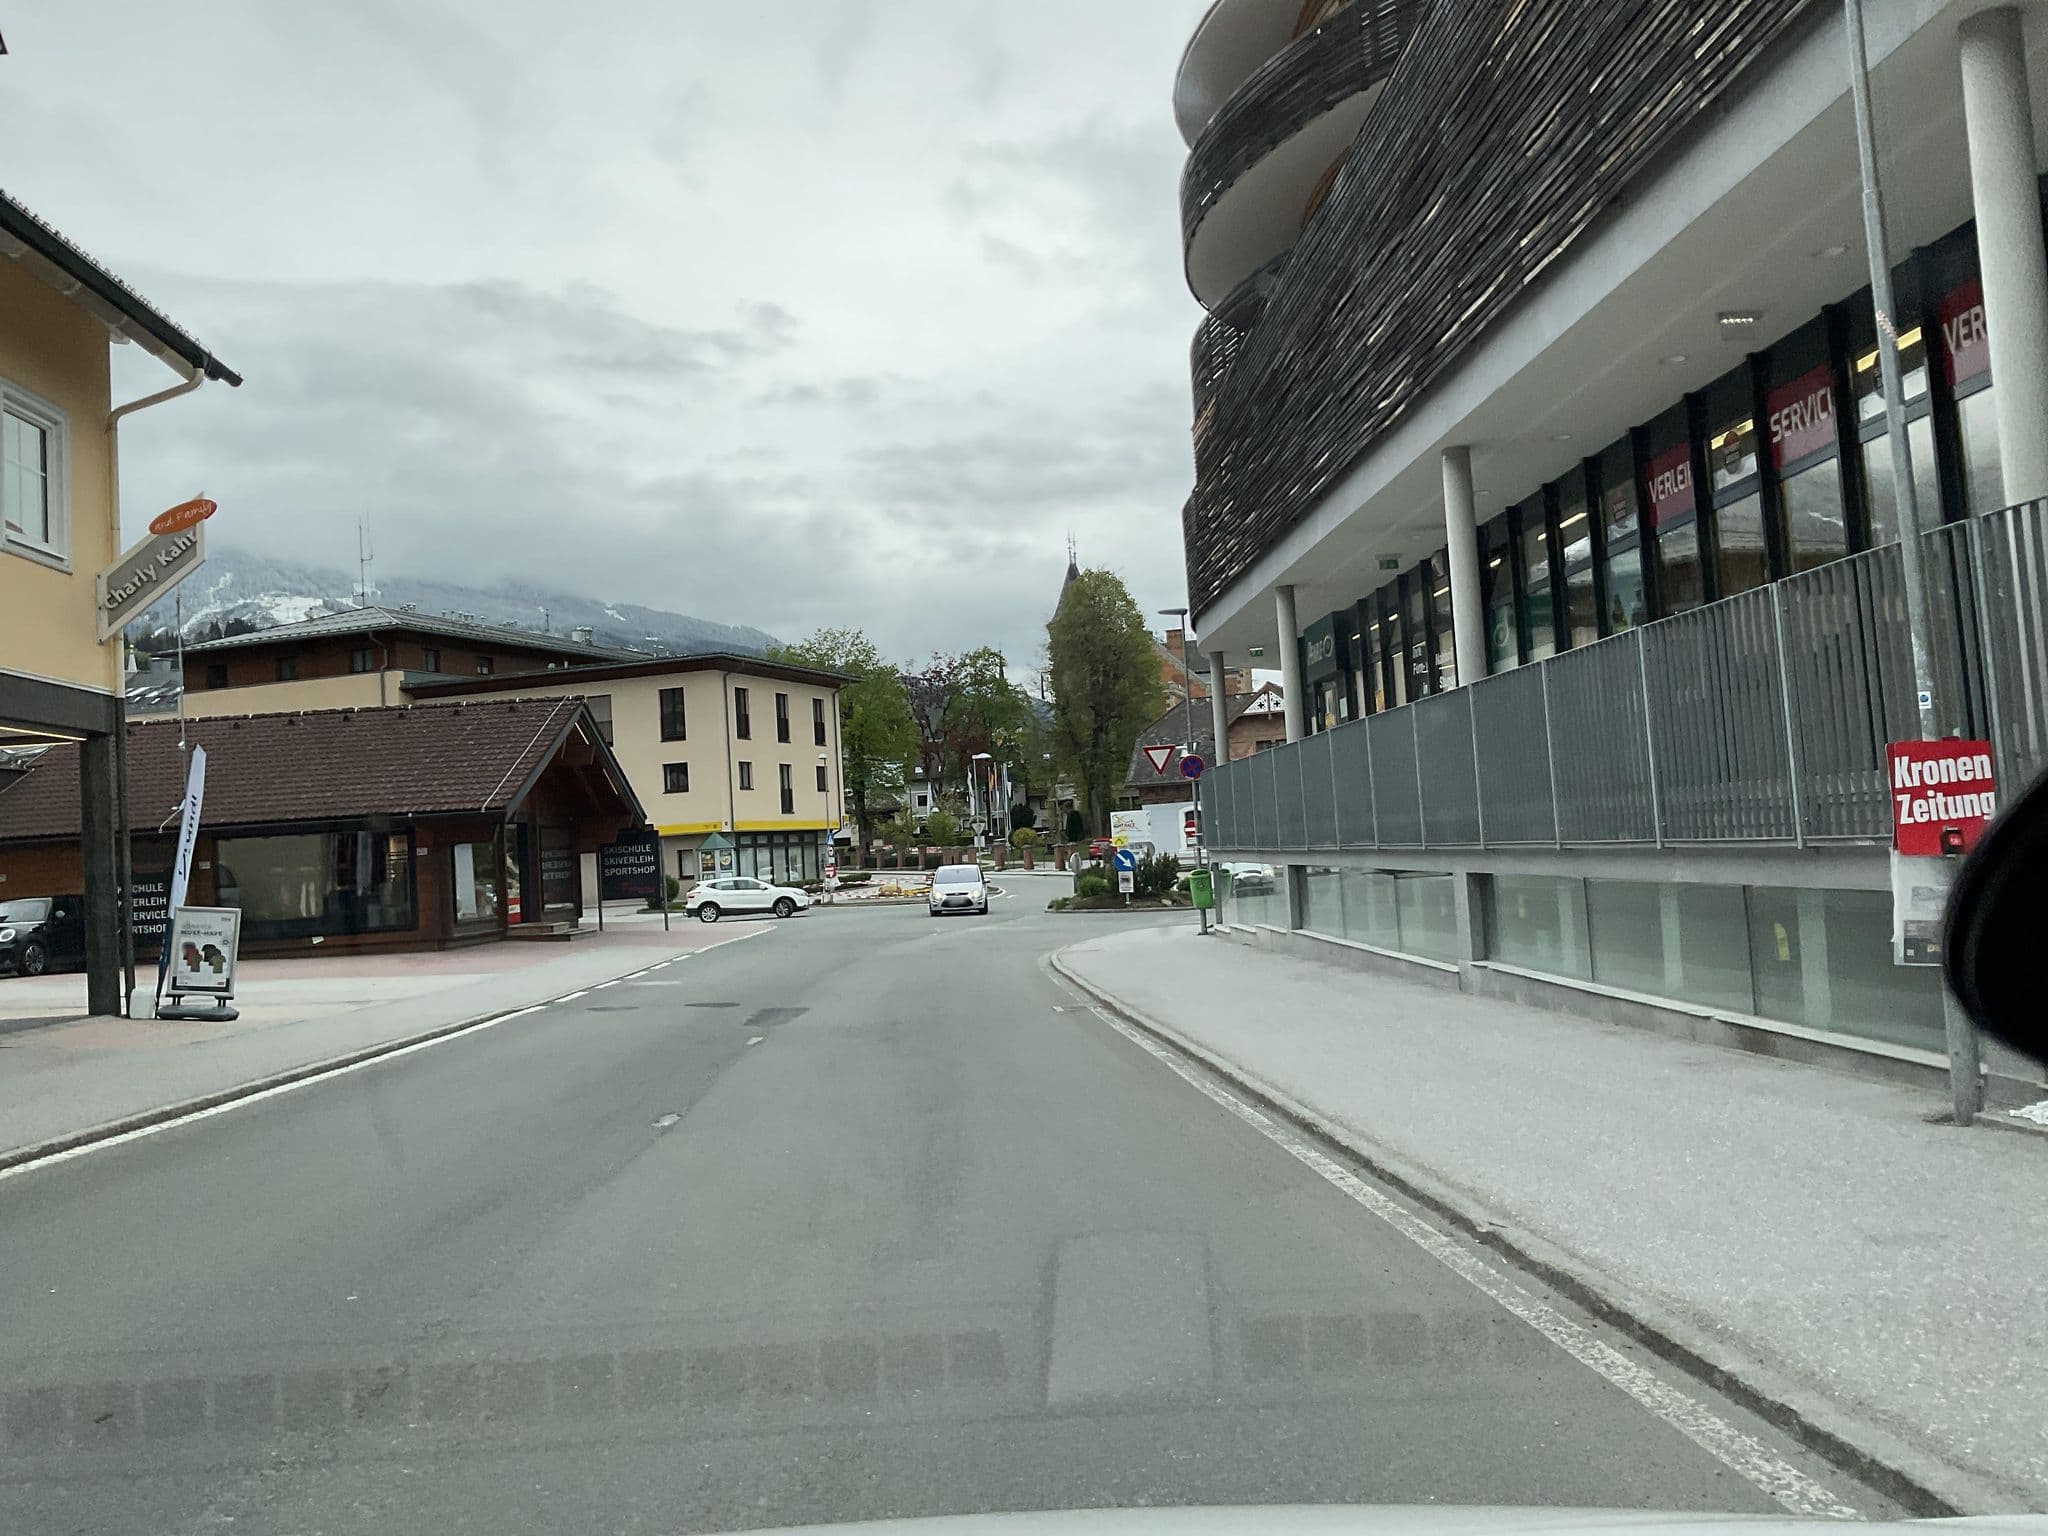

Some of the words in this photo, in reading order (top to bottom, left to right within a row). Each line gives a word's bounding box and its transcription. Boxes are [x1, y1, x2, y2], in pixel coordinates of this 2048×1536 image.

[1943, 304, 1988, 355] VER
[105, 563, 158, 609] Charly
[156, 531, 197, 566] Kahr
[1894, 753, 1993, 789] Kronen
[1897, 789, 1996, 825] Zeitung
[603, 844, 652, 855] SKISCHULE
[604, 855, 654, 866] SKIVERLEIH
[604, 865, 656, 877] SPORTSHOP
[132, 883, 165, 893] CHULE
[133, 897, 167, 907] ERLEIH
[133, 910, 167, 920] ERVICE
[132, 923, 168, 934] RTSHO
